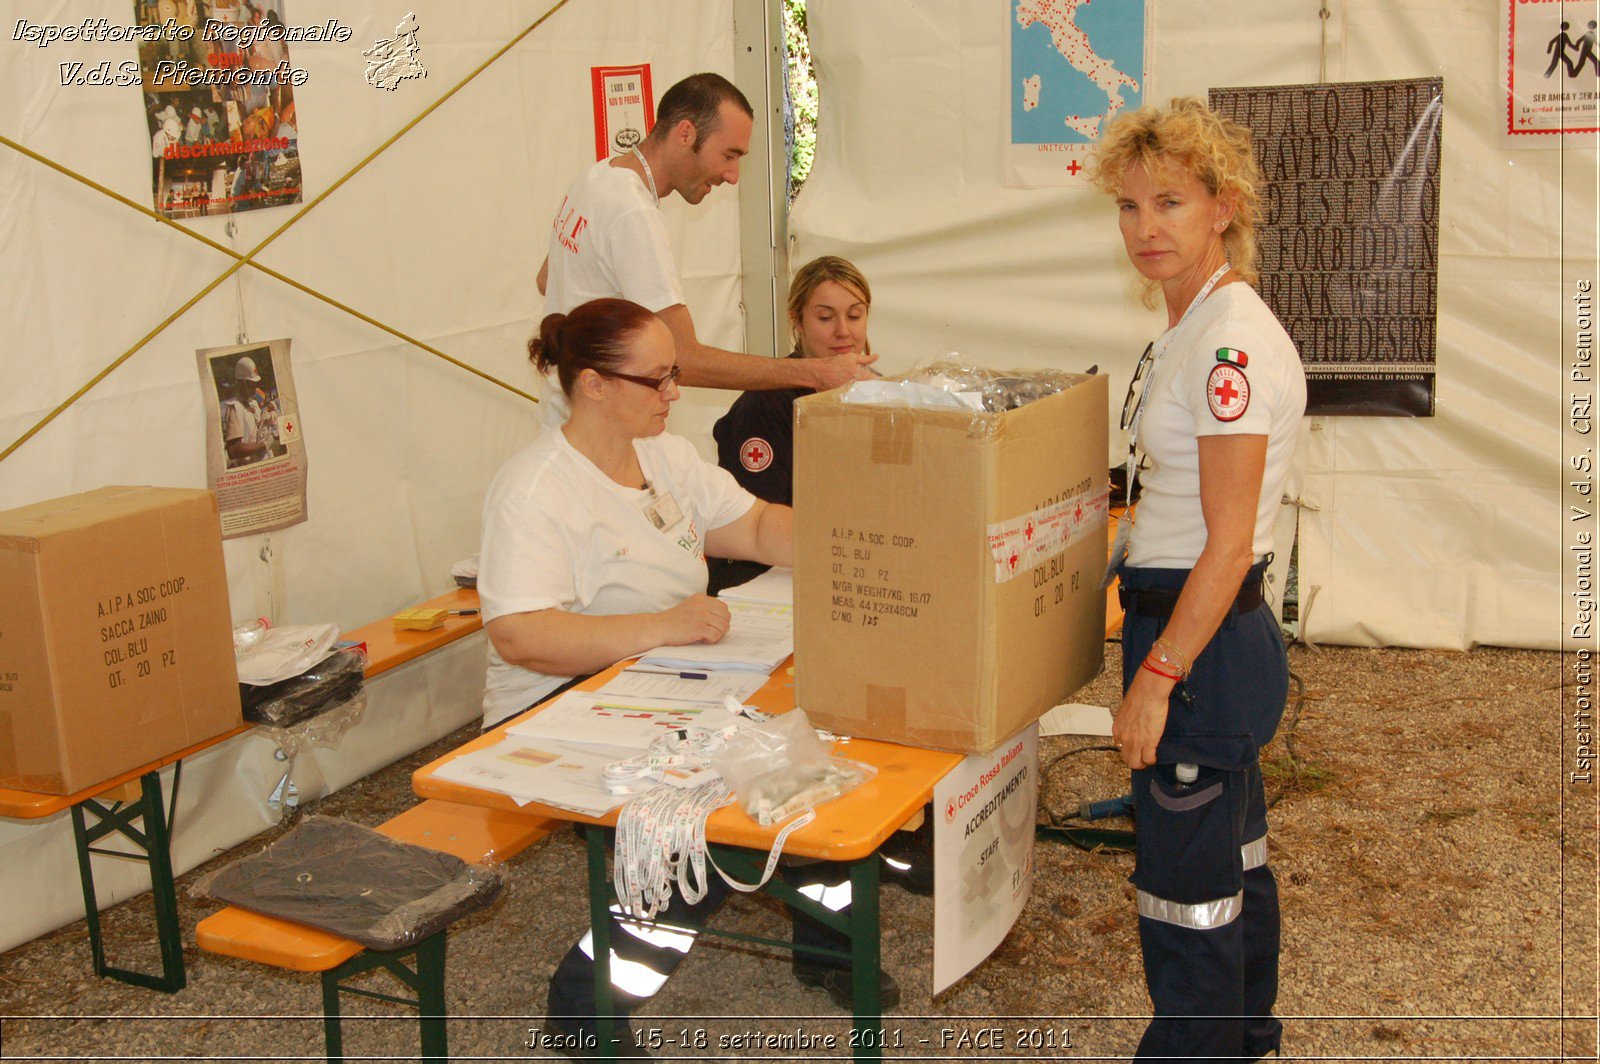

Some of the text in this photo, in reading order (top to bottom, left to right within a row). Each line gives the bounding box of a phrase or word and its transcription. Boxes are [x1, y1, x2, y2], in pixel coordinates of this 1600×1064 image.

[207, 50, 243, 69] ogni
[163, 135, 289, 160] discriminazione
[1038, 144, 1075, 152] UNITEVI
[1255, 131, 1441, 181] RAVERSANDO
[1267, 177, 1436, 226] DESERTO
[1278, 225, 1437, 272] FORBIDDEN
[854, 549, 870, 560] BLU
[853, 567, 865, 579] 20
[878, 569, 889, 581] PZ
[1055, 582, 1064, 605] 20
[1072, 571, 1080, 593] PZ
[137, 586, 156, 605] SOC
[101, 607, 167, 642] SACCA ZAINO
[137, 660, 151, 678] 20
[162, 650, 176, 668] PZ
[957, 741, 1024, 809] Croce Rossa Italiana
[964, 766, 1028, 839] ACCREDITAMENTO
